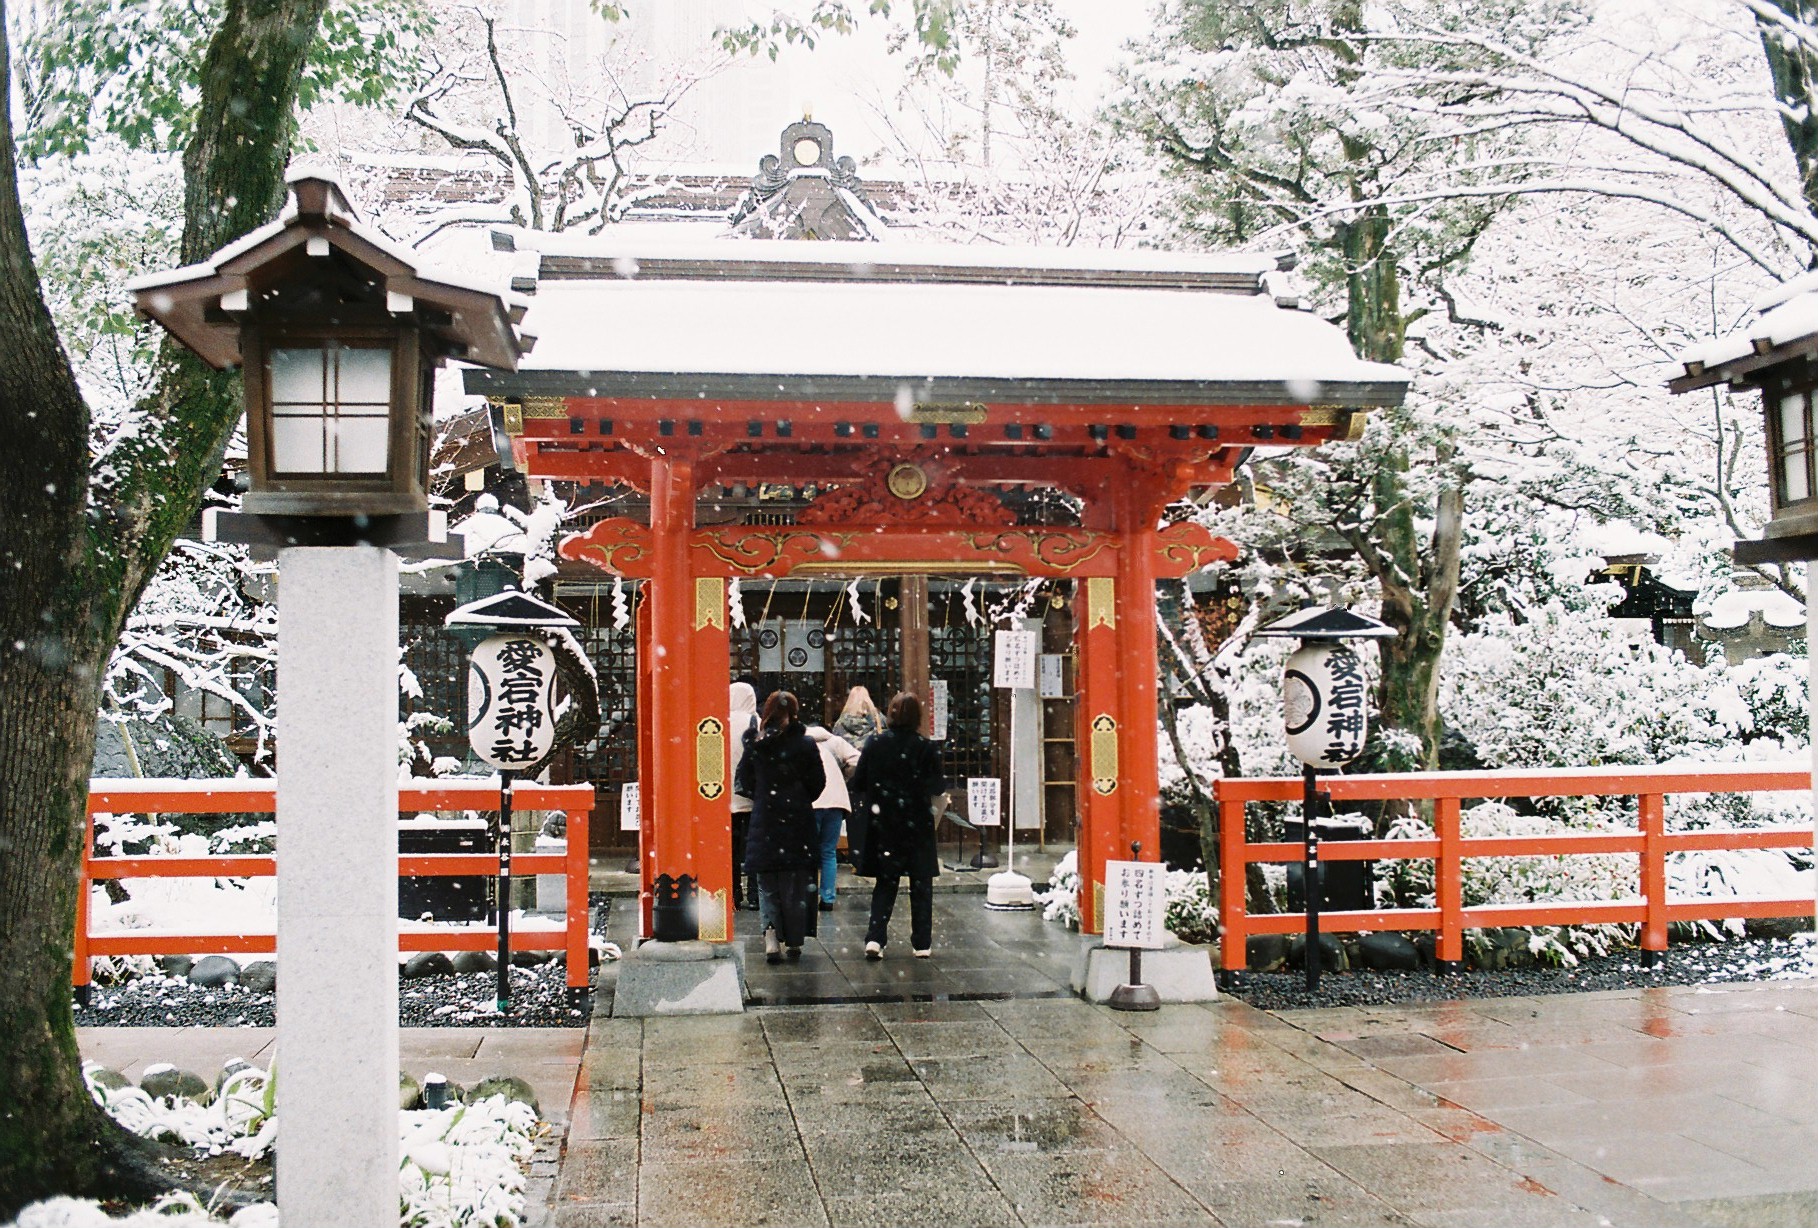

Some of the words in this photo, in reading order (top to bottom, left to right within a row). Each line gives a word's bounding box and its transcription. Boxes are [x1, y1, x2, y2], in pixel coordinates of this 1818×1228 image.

[490, 639, 544, 763] 愛宕神社
[1320, 649, 1364, 763] 愛宕神社
